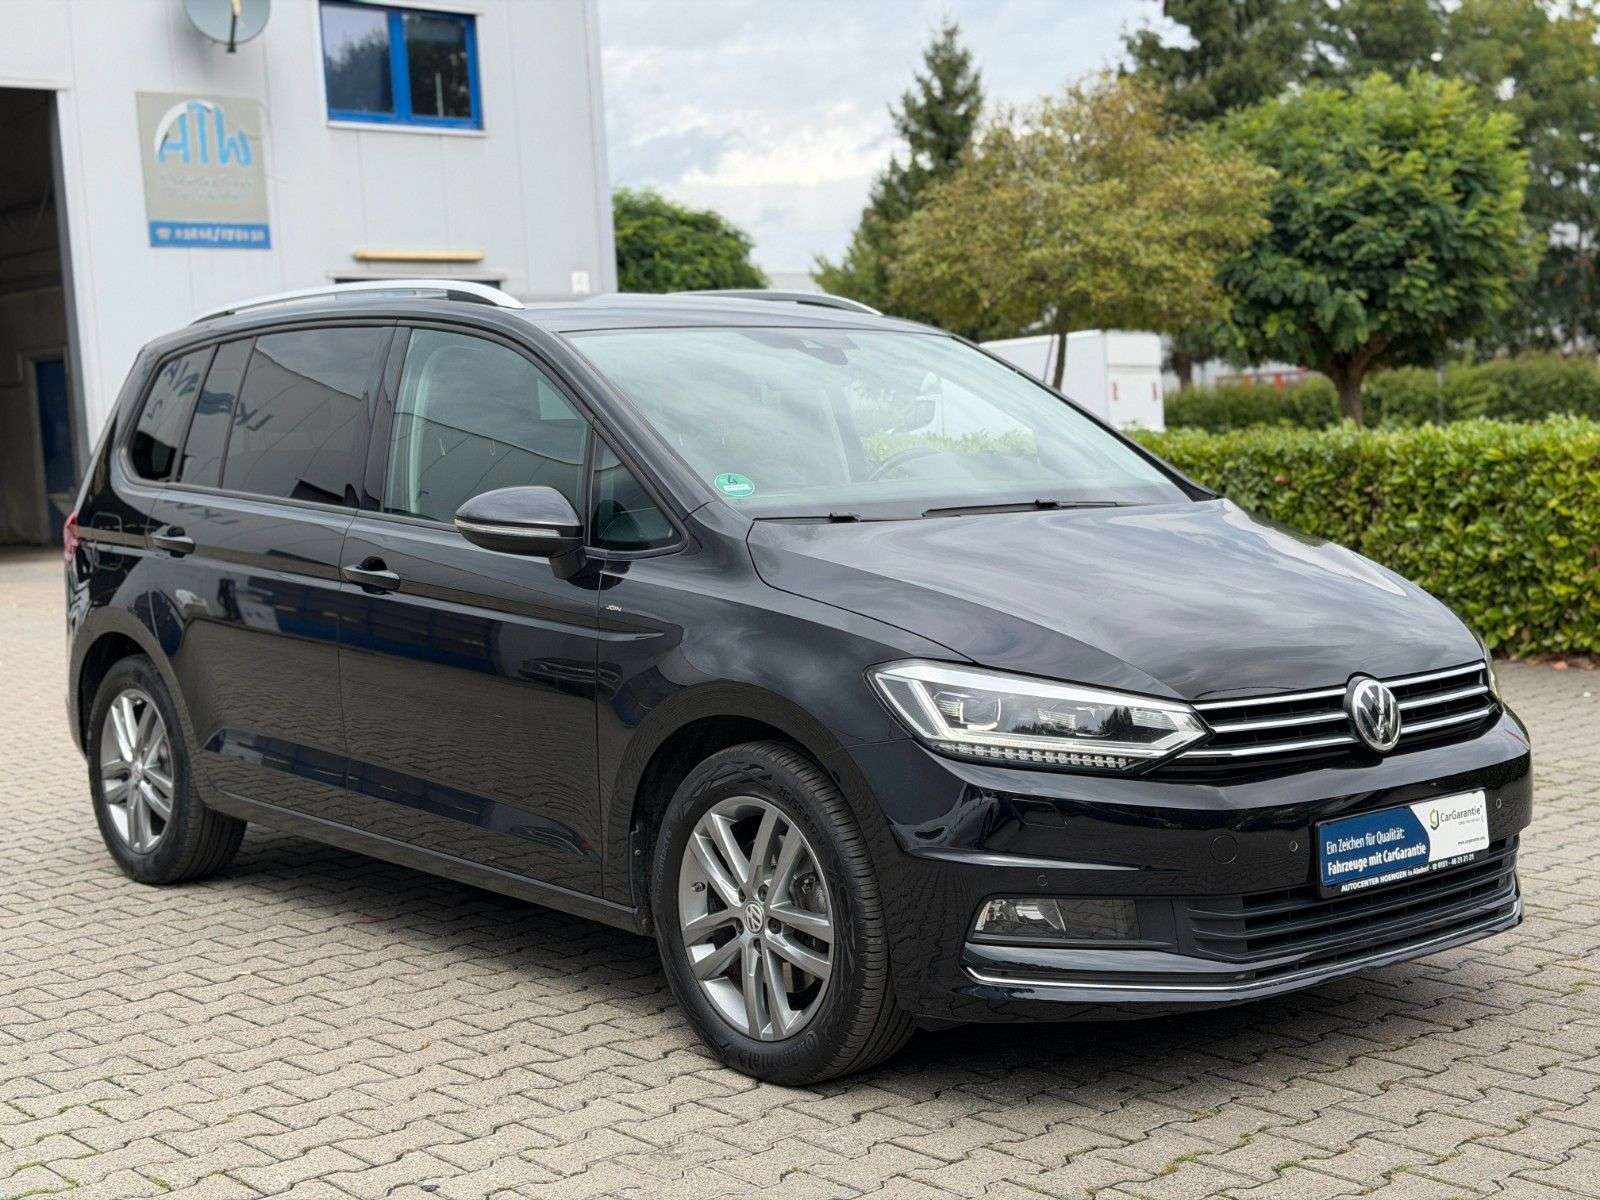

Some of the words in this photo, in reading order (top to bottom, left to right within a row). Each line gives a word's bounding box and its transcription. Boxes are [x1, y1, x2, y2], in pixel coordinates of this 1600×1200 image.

[1440, 807, 1481, 822] CarGarantie
[1326, 841, 1338, 855] Ein
[1338, 836, 1365, 853] Zeichen
[1365, 833, 1375, 846] für
[1376, 828, 1405, 845] Qualität:
[1327, 857, 1368, 876] Fahrzeuge
[1369, 852, 1382, 866] mit
[1383, 843, 1427, 863] CarGarantie
[1341, 877, 1380, 892] AUTOCENTER
